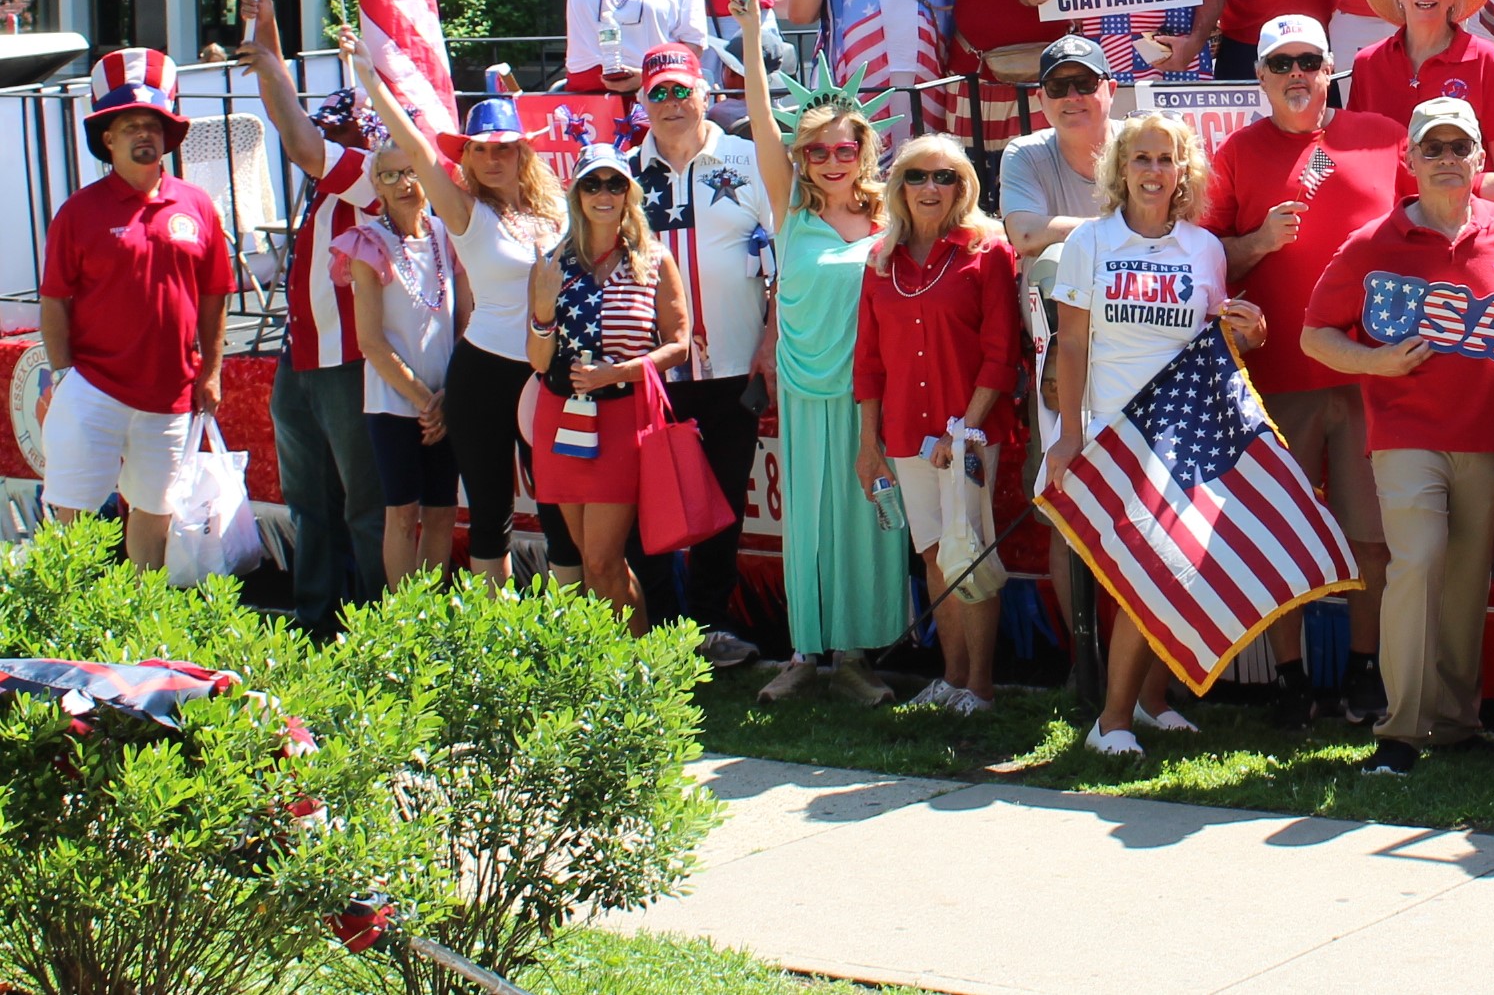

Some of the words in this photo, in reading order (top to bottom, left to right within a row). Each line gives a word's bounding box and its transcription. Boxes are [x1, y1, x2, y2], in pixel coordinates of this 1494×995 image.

[1158, 93, 1257, 106] GOVERNOR
[1183, 112, 1246, 157] ACK
[1109, 261, 1189, 273] GOVERNOR
[1105, 271, 1179, 304] JACK
[1105, 303, 1194, 328] CIATTARELLI
[13, 367, 28, 411] ESSEX
[26, 350, 46, 367] COU
